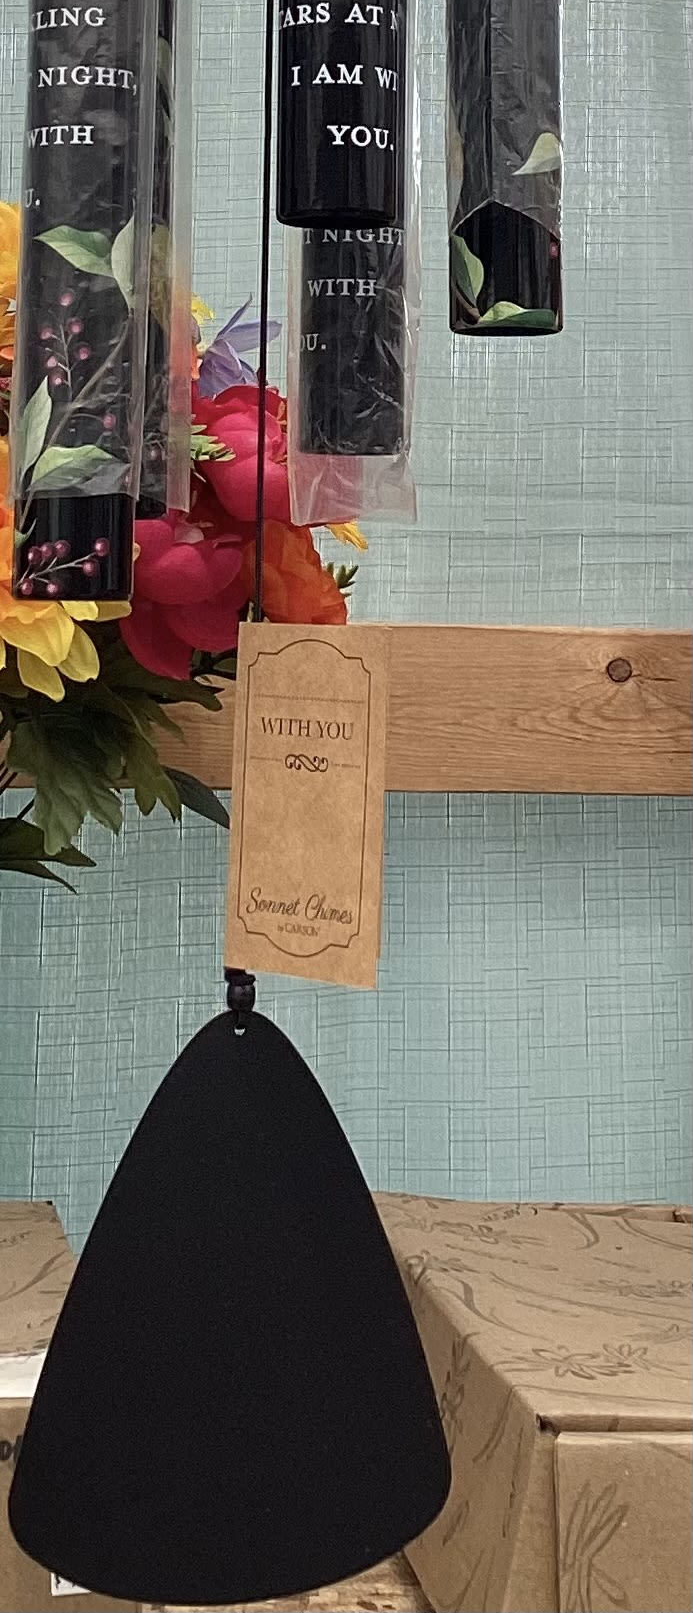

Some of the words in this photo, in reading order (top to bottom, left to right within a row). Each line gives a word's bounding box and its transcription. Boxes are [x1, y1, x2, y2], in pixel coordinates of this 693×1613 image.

[344, 3, 383, 26] AT
[37, 66, 137, 96] NIGHT,
[291, 65, 301, 86] I
[312, 63, 364, 85] AM
[326, 125, 394, 151] YOU.
[307, 278, 377, 297] WITH
[261, 716, 311, 738] WITH
[316, 720, 354, 740] YOU
[246, 887, 300, 916] Sonnet
[305, 894, 352, 924] Chimes
